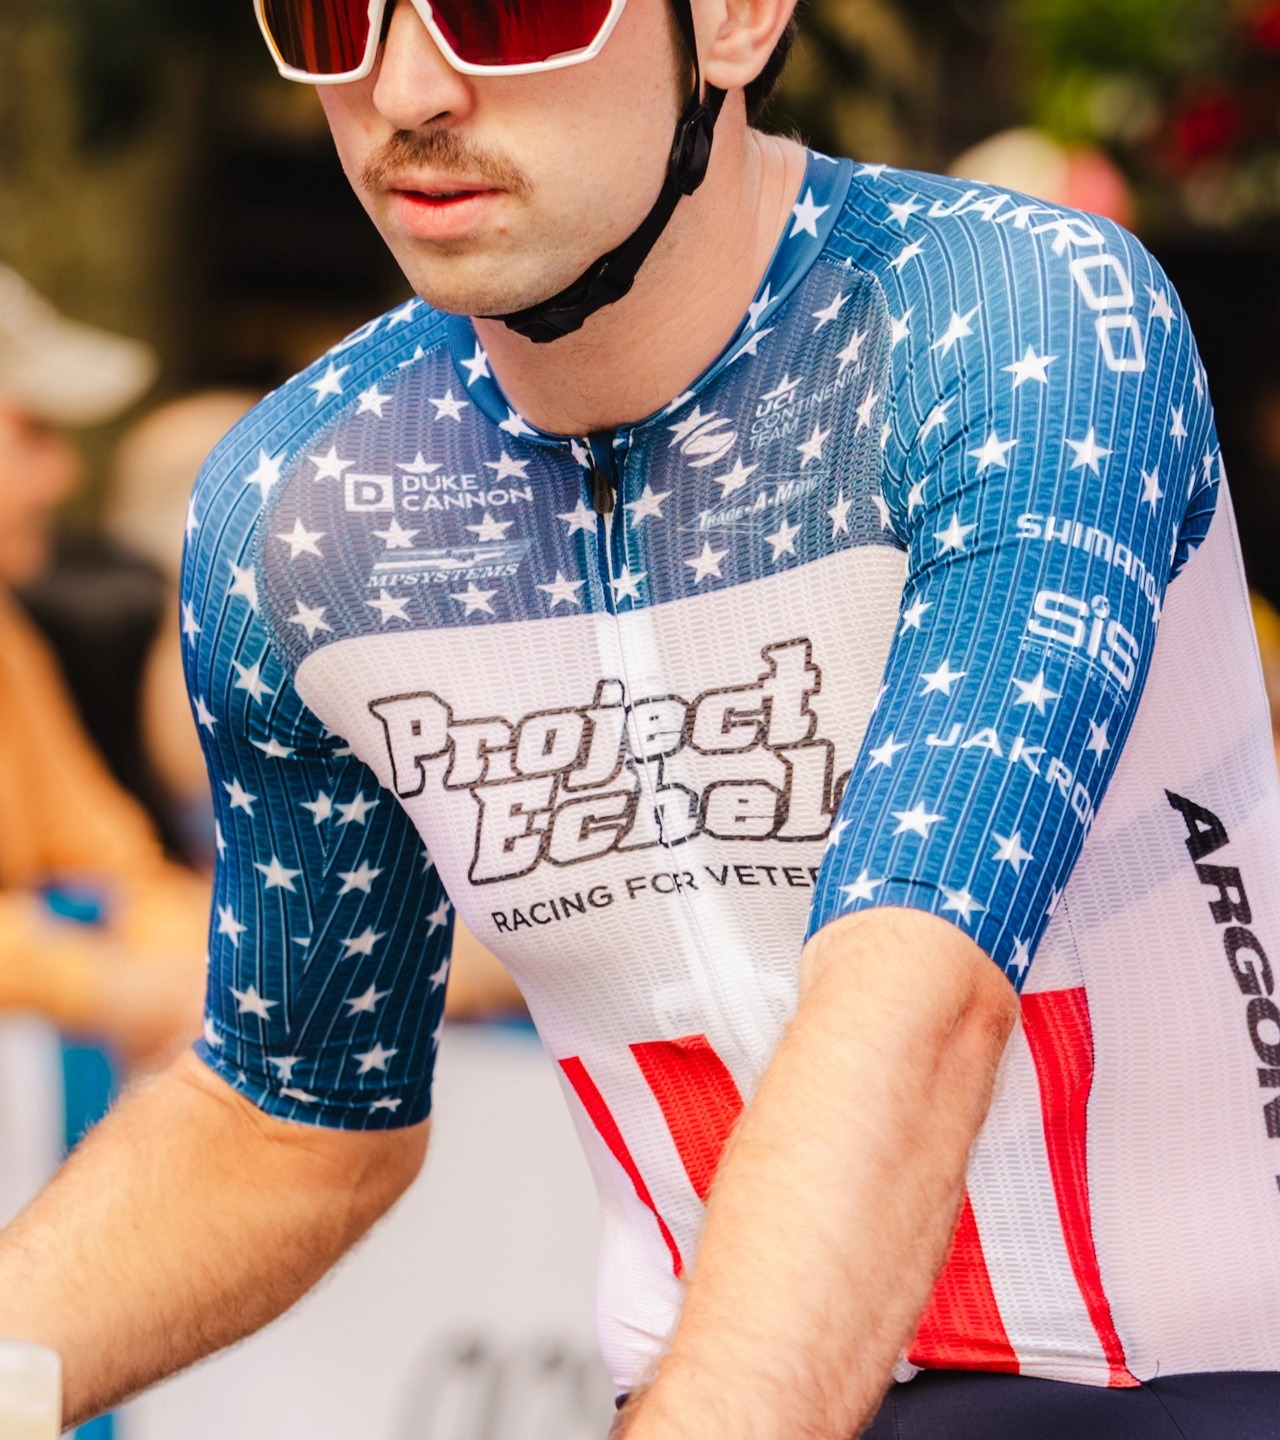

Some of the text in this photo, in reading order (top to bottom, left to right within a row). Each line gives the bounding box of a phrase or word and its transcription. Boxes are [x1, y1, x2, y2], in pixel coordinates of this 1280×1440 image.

[927, 190, 1146, 373] JAKROO
[751, 358, 867, 434] CONTINENTAL
[756, 390, 795, 418] UCI
[749, 418, 799, 450] TEAM
[401, 486, 534, 511] CANNON
[402, 474, 479, 492] DUKE
[366, 563, 521, 587] MPSYSTEMS
[1016, 514, 1156, 606] SHIMANO
[1022, 643, 1083, 672] SCIENCE
[368, 636, 821, 799] Project
[468, 738, 853, 886] Echel
[492, 865, 821, 933] RACING FOR VETE
